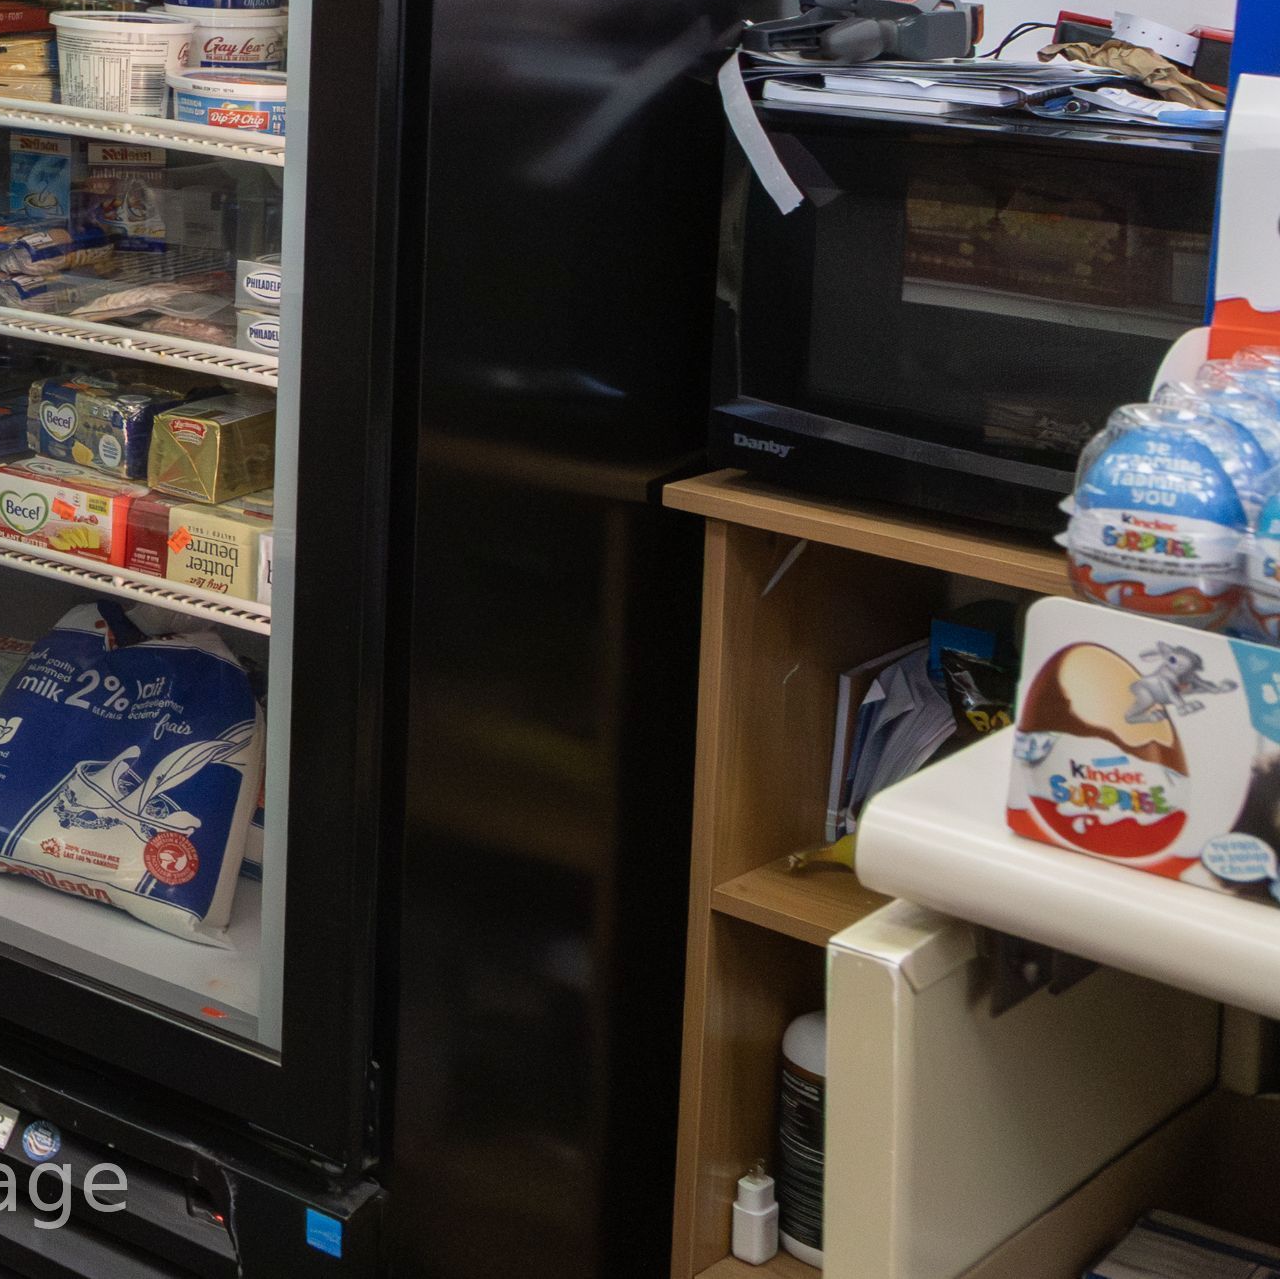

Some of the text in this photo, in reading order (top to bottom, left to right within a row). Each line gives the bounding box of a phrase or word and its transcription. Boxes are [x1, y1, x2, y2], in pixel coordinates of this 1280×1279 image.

[203, 36, 262, 56] Gay Lea
[102, 147, 153, 162] Neilson
[46, 410, 72, 430] Becel
[733, 432, 795, 459] Danby
[6, 498, 41, 520] Becel
[1131, 490, 1177, 508] YOU
[185, 539, 239, 568] beurre
[1103, 525, 1197, 558] SURPRISE
[185, 556, 234, 585] butter
[188, 577, 229, 595] Gay Lea
[46, 657, 76, 674] partly
[20, 675, 64, 703] milk
[64, 669, 130, 712] 2%
[153, 713, 193, 741] frais
[1049, 774, 1173, 815] SURPRISE
